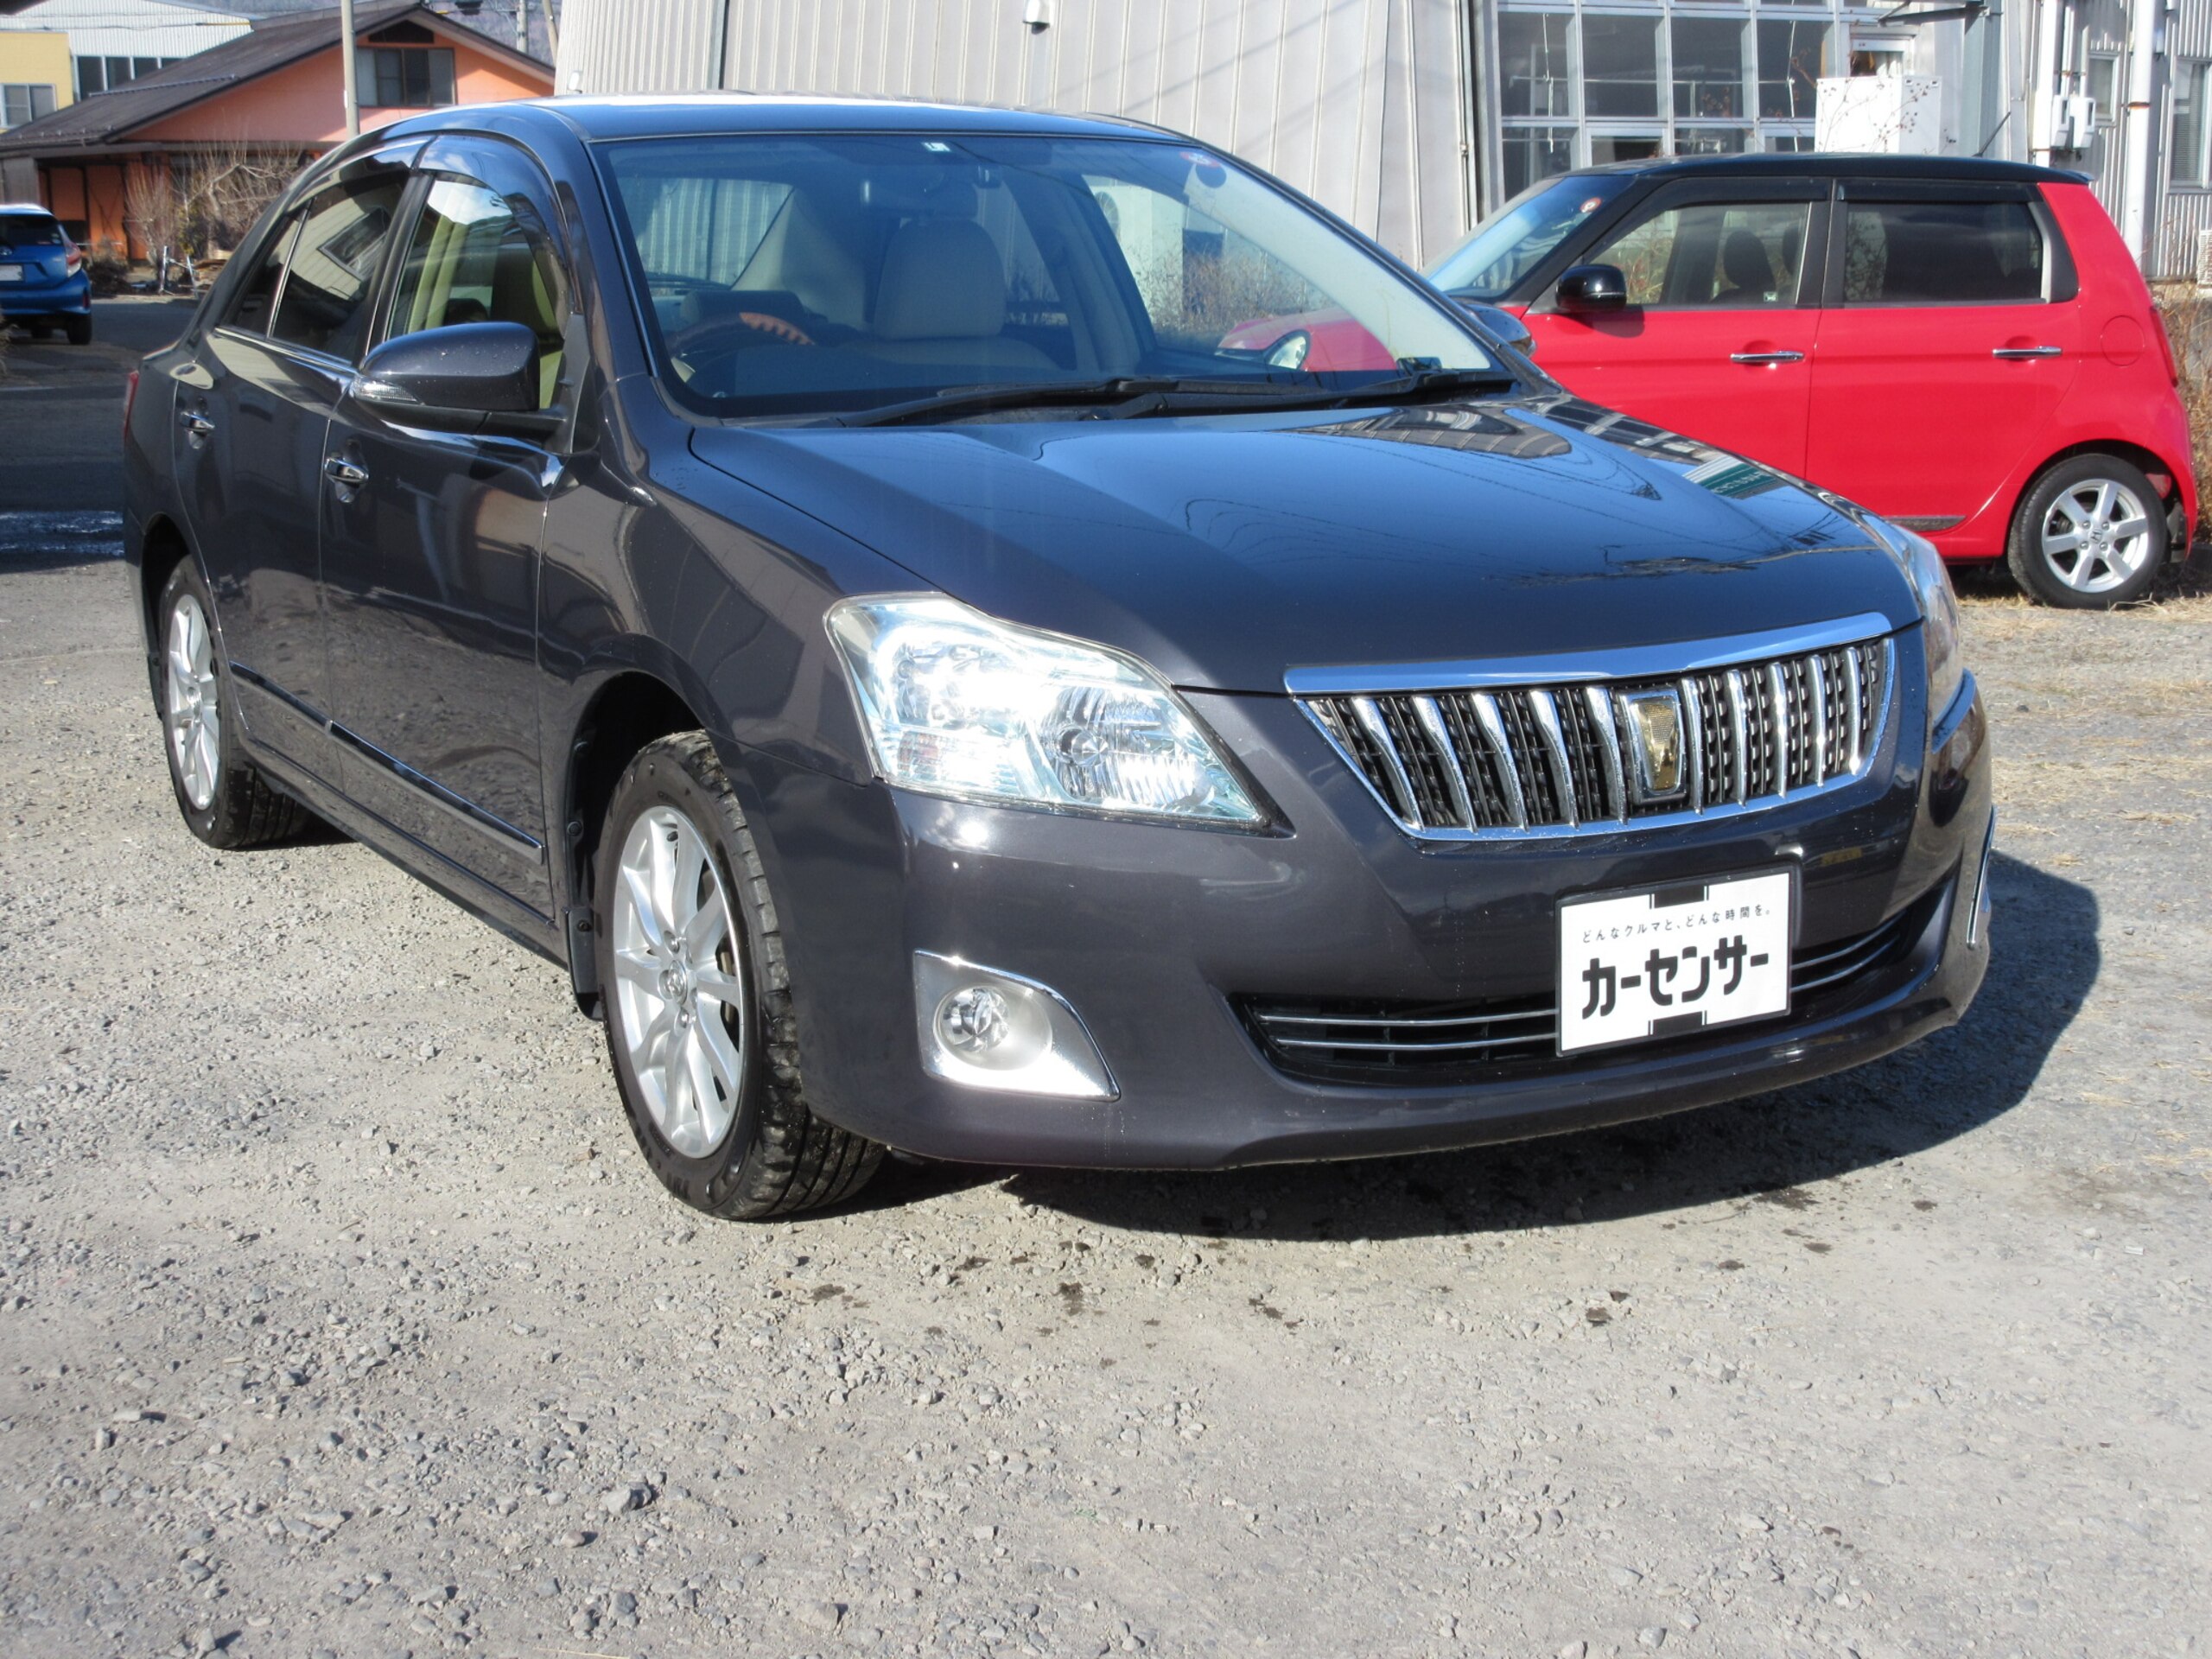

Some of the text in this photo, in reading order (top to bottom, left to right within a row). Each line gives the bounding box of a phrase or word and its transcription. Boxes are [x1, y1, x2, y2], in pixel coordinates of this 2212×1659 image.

[1582, 935, 1769, 1020] カーセンサー
